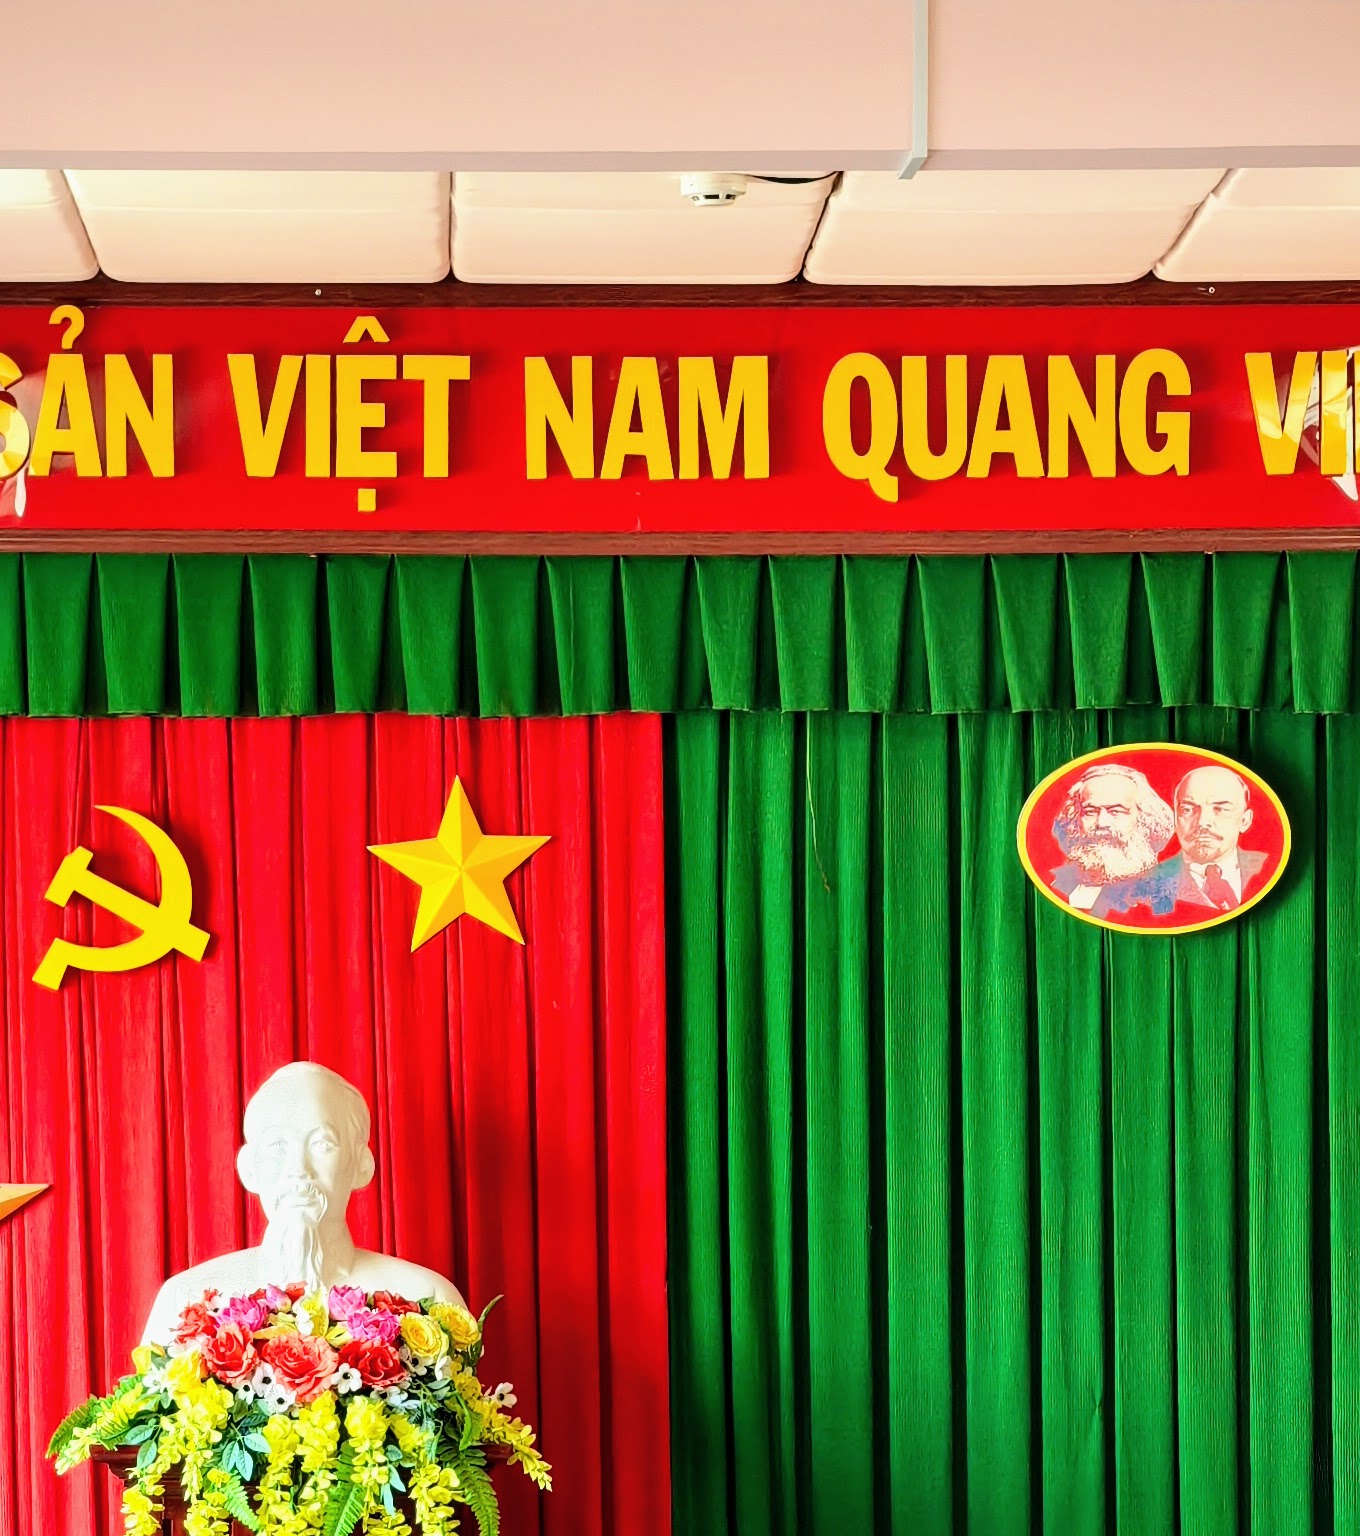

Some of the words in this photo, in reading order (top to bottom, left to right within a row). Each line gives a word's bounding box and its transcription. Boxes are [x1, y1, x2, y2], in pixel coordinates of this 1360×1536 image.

[227, 315, 471, 513] VIỆT
[524, 355, 770, 481] NAM
[822, 348, 1193, 503] QUANG
